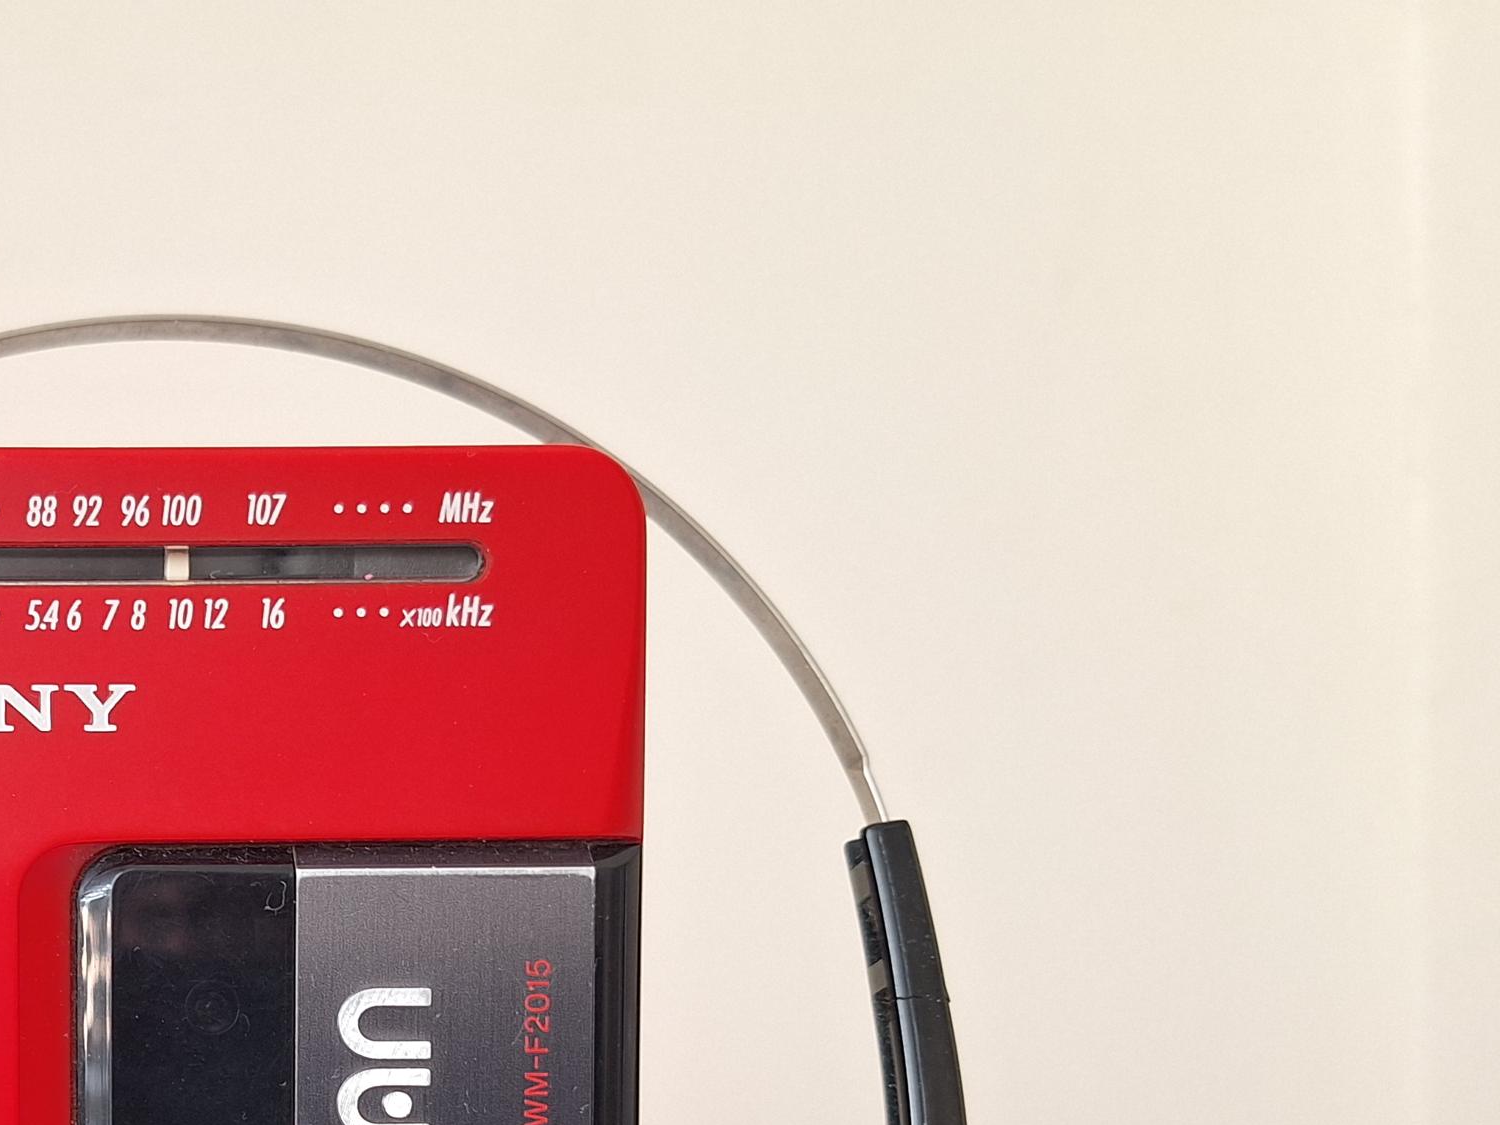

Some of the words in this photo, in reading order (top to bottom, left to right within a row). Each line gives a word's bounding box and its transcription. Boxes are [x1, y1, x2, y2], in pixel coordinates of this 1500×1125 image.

[25, 494, 58, 528] 88
[72, 494, 103, 527] 92
[120, 494, 150, 527] 96
[161, 494, 203, 527] 100
[247, 493, 287, 526] 107
[438, 491, 495, 524] MHz
[66, 599, 82, 632] 6
[102, 599, 121, 631] 7
[130, 599, 147, 631] 8
[168, 598, 194, 630] 10
[203, 597, 229, 630] 12
[261, 597, 286, 630] 16
[445, 592, 494, 627] kHz
